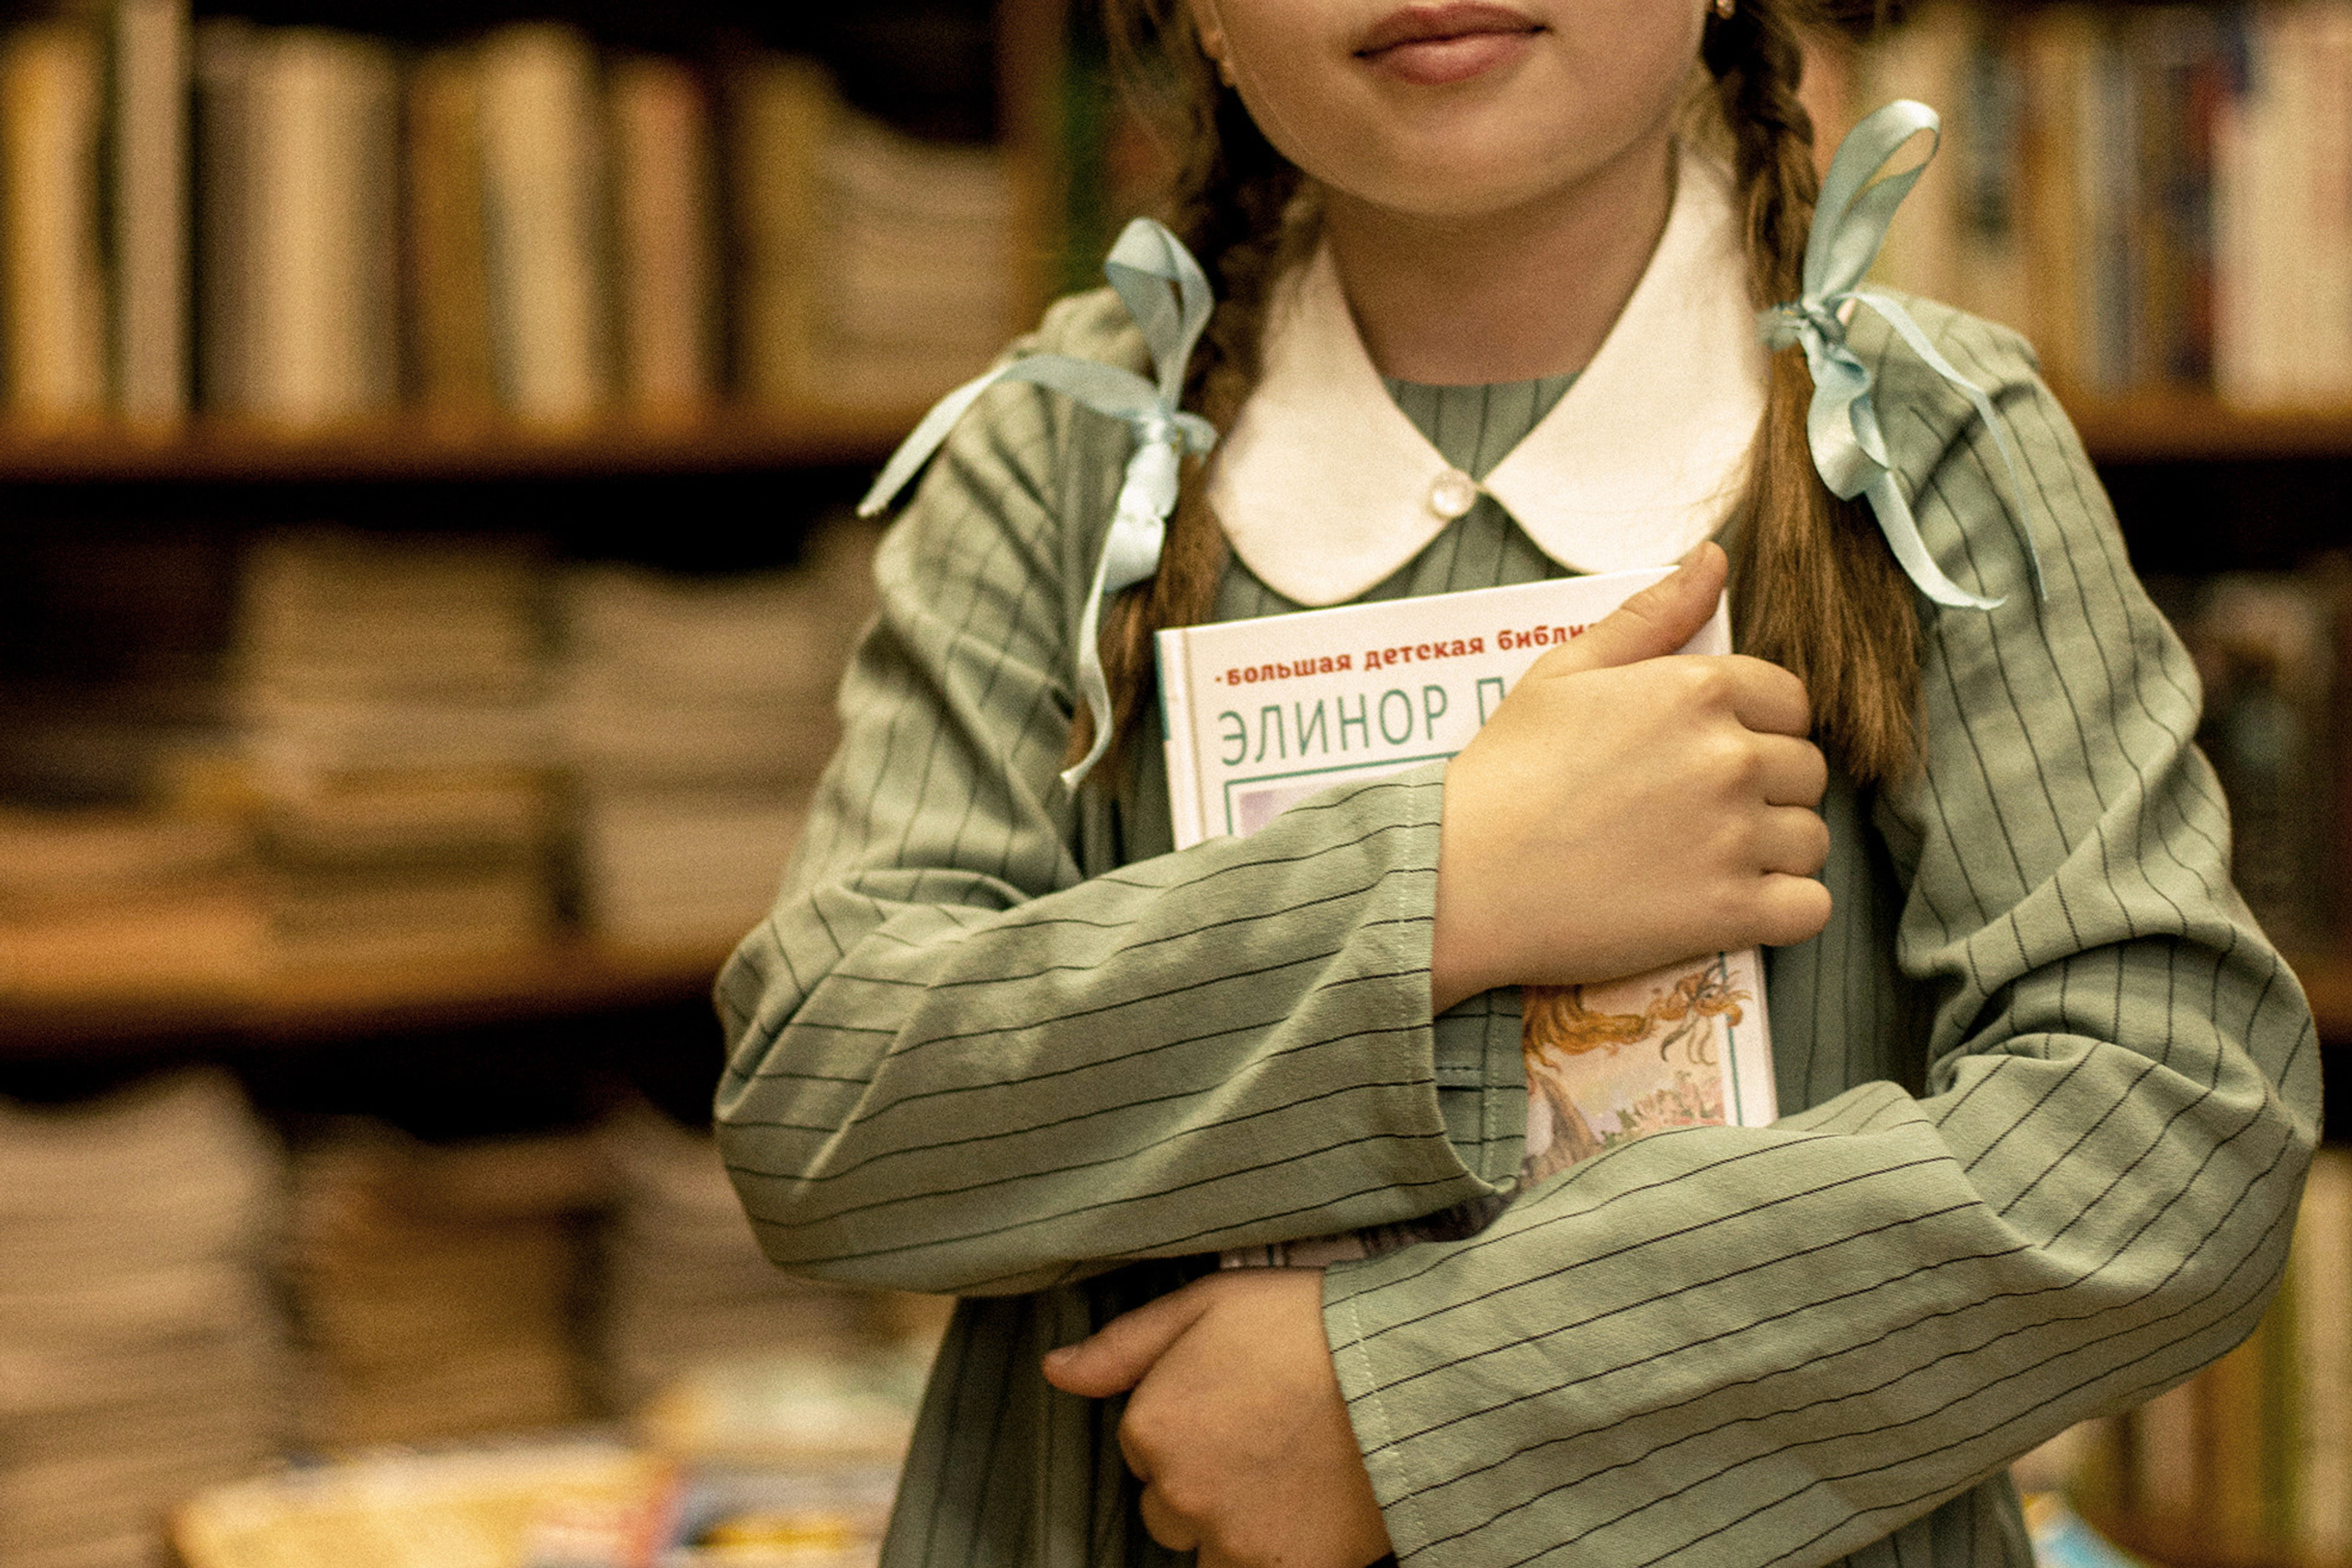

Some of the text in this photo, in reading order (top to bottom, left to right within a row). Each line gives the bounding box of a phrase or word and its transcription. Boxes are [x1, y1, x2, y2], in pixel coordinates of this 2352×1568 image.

[1364, 637, 1485, 671] детская
[1497, 623, 1597, 650] библи
[1217, 684, 1448, 767] ЭЛИНОР
